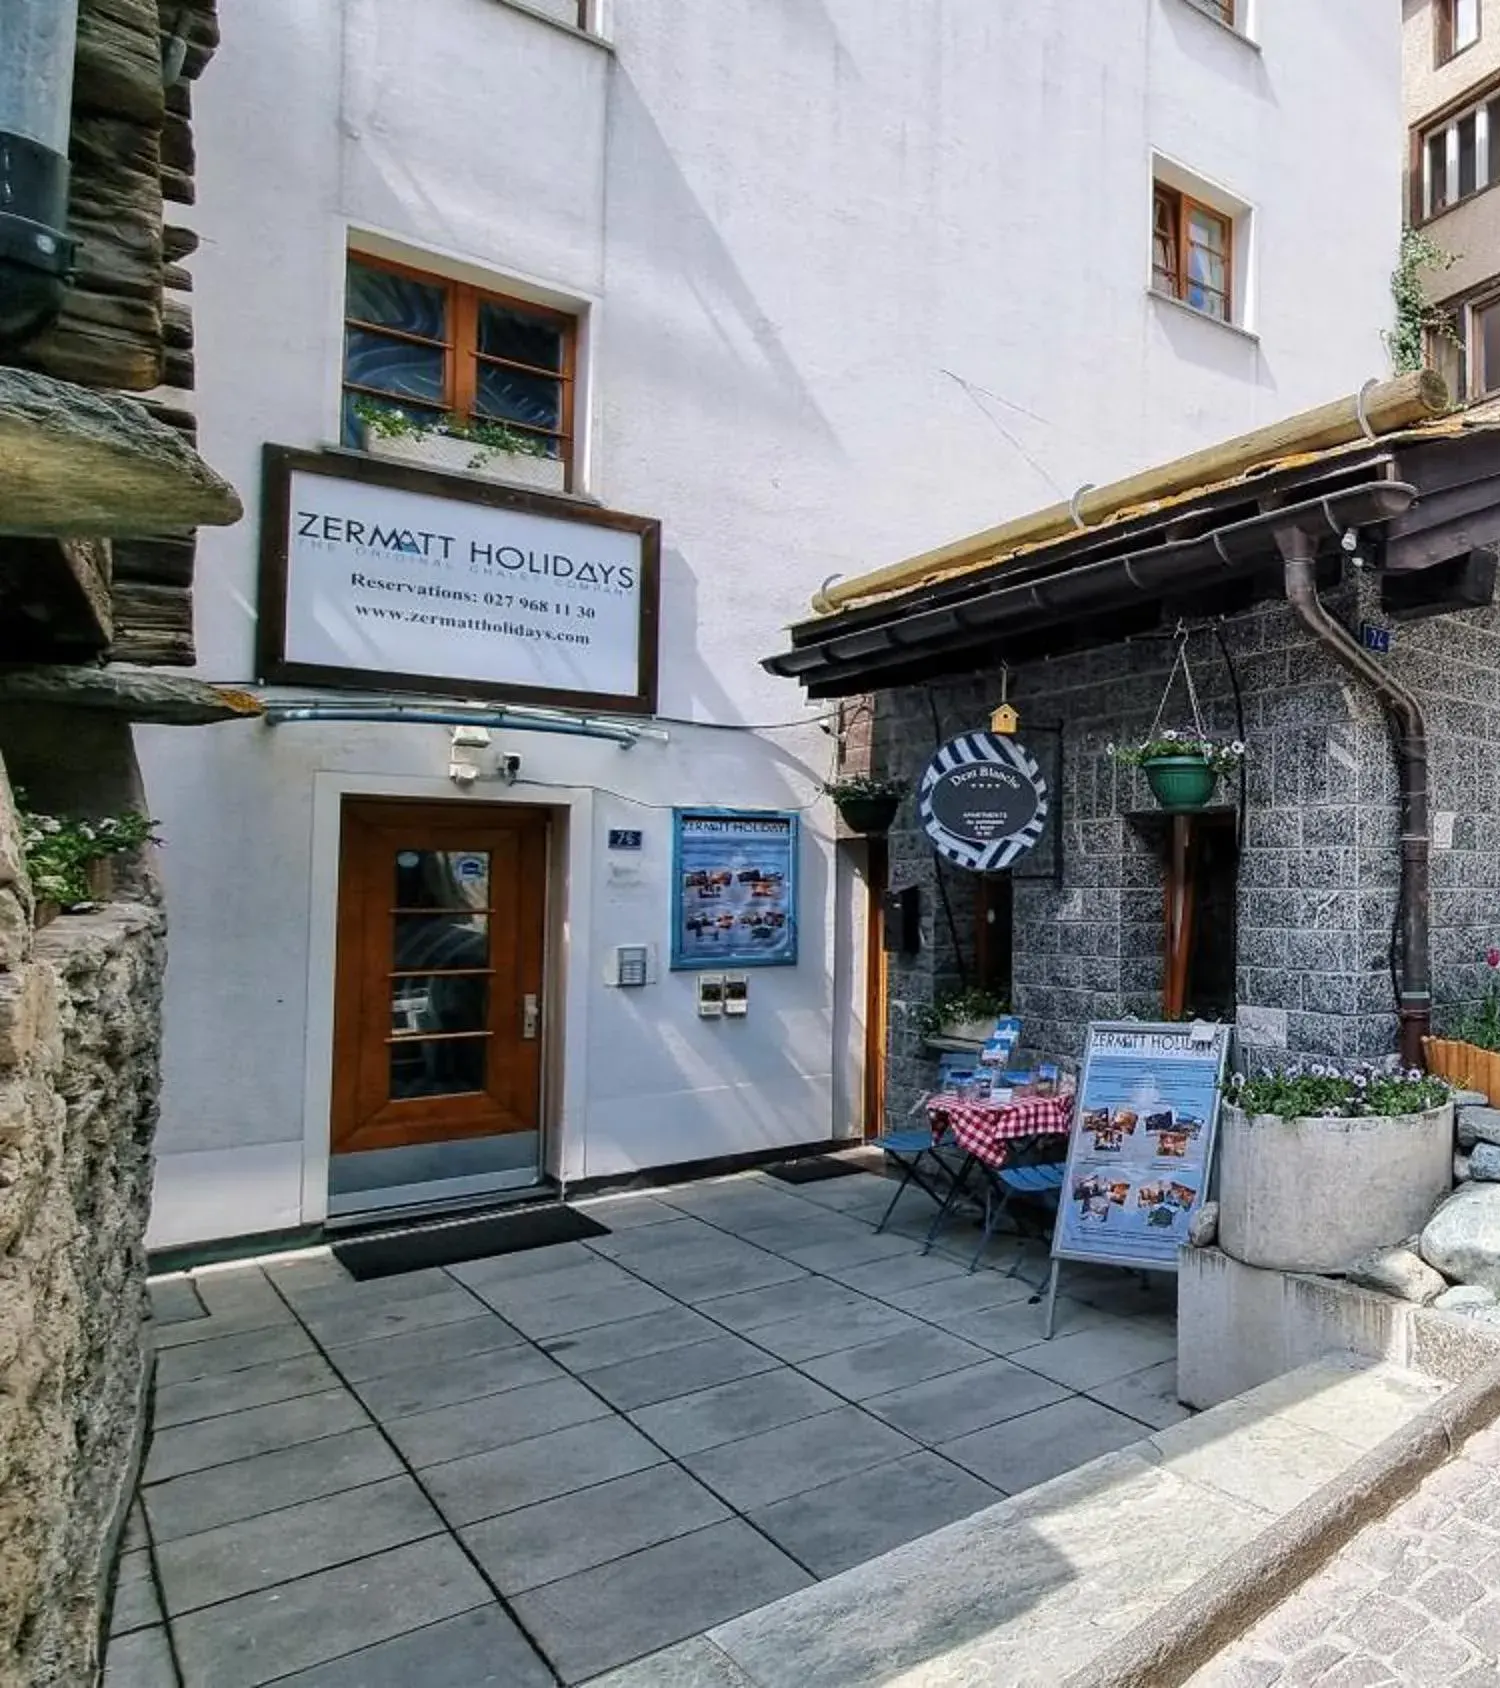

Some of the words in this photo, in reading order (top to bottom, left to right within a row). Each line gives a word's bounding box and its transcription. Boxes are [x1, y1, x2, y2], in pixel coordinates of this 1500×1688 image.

[297, 511, 456, 559] ZERMATT
[470, 541, 634, 589] HOLIDAYS
[351, 573, 478, 603] Reservations:
[484, 592, 513, 608] 027
[520, 597, 549, 613] 968
[555, 603, 570, 616] 11
[577, 606, 595, 619] 30
[355, 605, 590, 645] www.zermattholidays.com
[1092, 1033, 1146, 1049] ZERMATT
